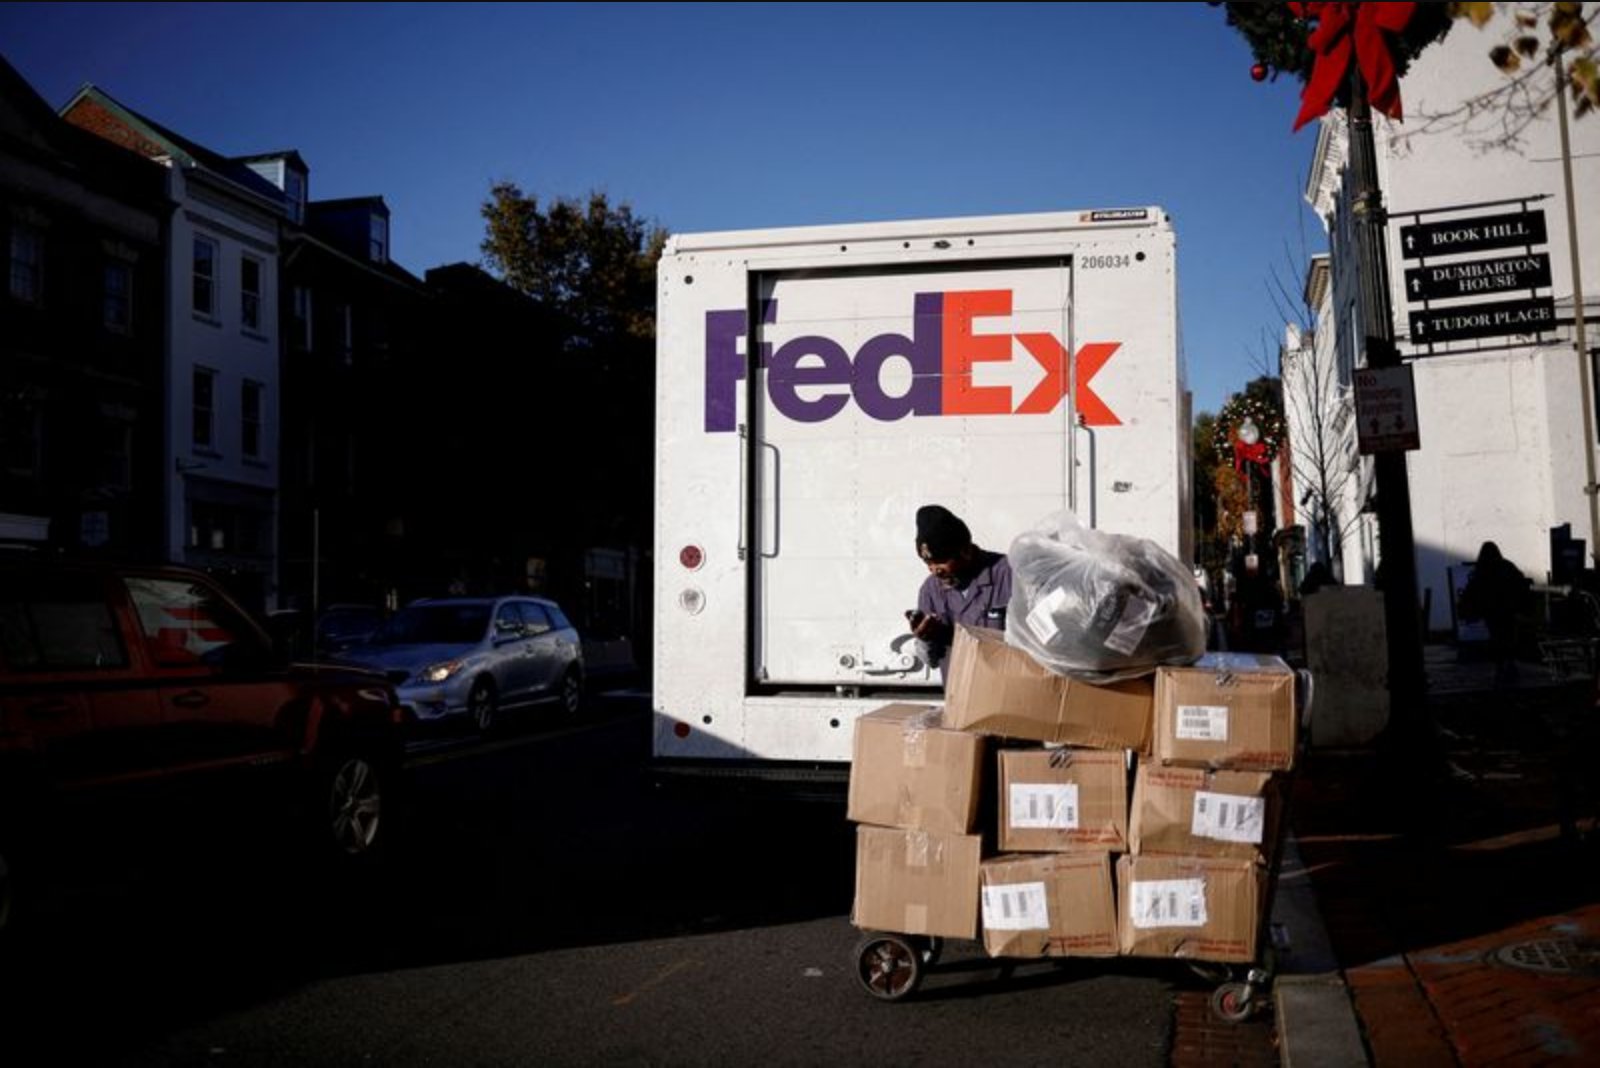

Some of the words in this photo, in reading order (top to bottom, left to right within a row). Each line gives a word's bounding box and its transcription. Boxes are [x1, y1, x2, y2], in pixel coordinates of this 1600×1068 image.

[1431, 227, 1480, 245] BOOK
[1484, 222, 1529, 239] HILL
[1081, 254, 1130, 269] 206034
[1432, 257, 1541, 282] DUMBARTON
[1459, 274, 1517, 292] HOUSE
[1432, 315, 1491, 331] TUDOR
[1494, 307, 1551, 326] PLACE
[704, 289, 1123, 433] FedEx
[1358, 374, 1377, 387] No
